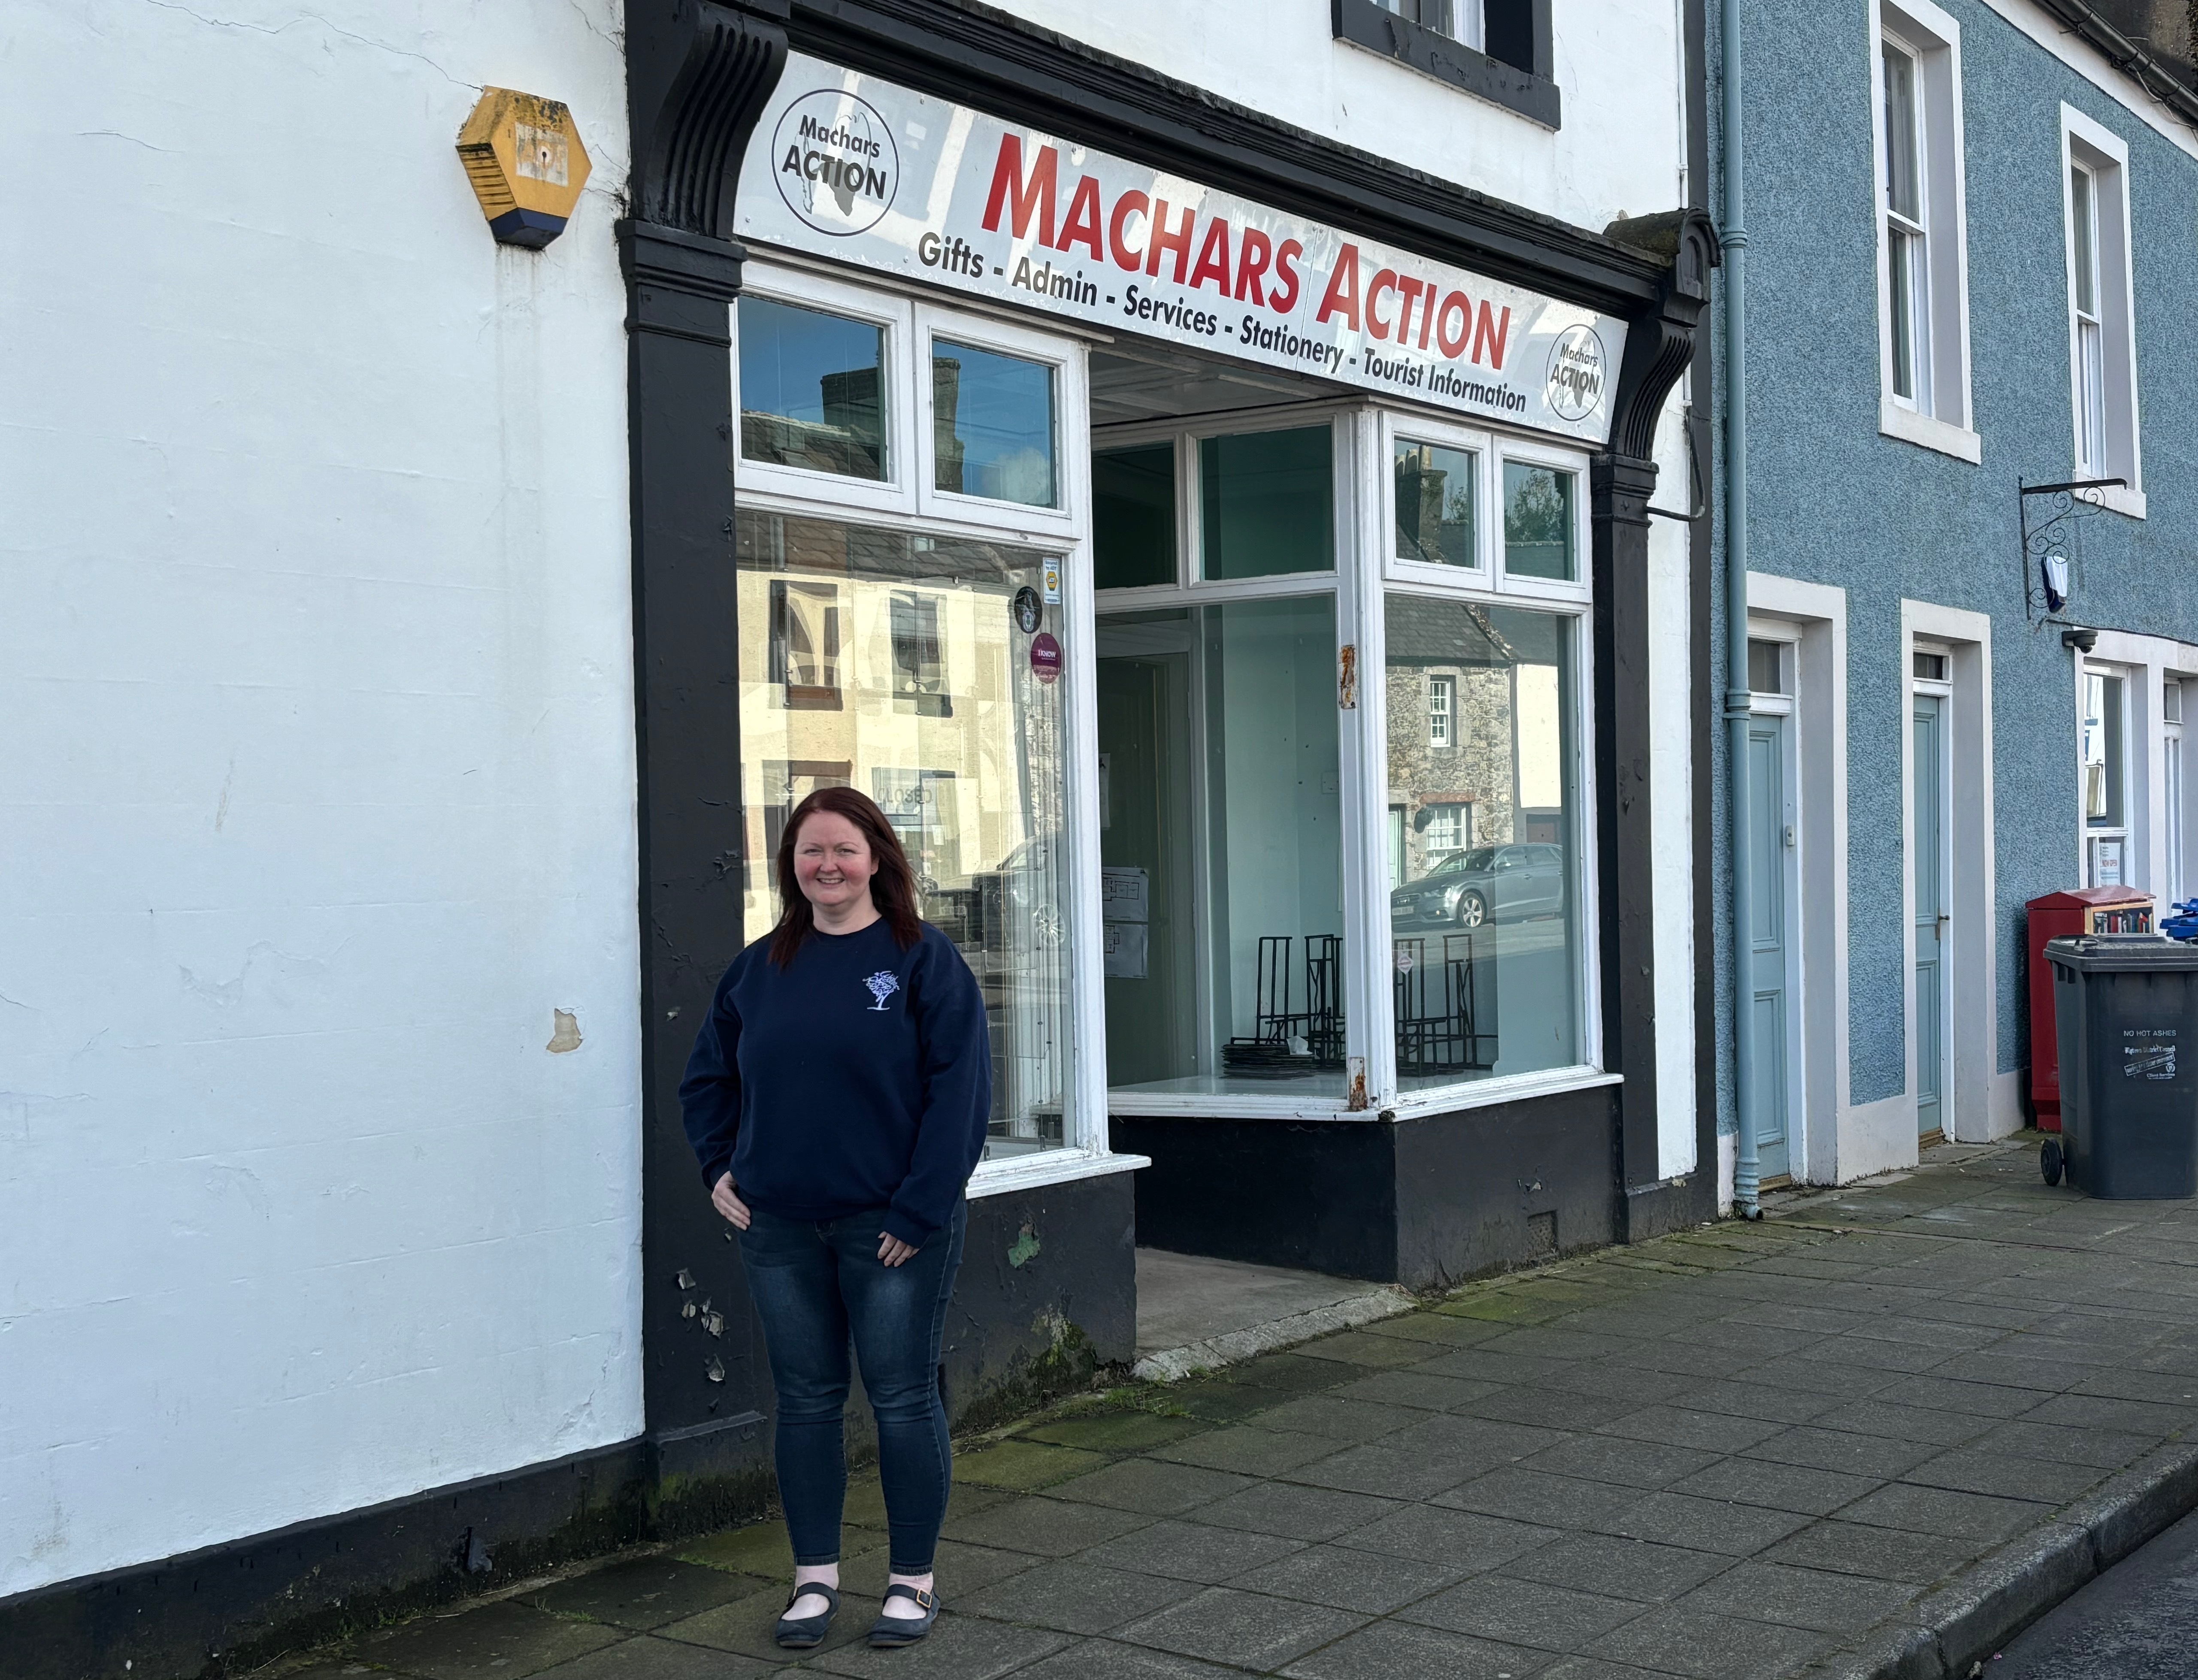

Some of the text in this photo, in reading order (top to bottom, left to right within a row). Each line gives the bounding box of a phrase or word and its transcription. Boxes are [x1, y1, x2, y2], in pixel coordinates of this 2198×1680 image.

[799, 114, 880, 158] Machars
[782, 145, 886, 199] ACTION
[981, 132, 1511, 370] MACHARS ACTION
[919, 232, 984, 278] Gifts
[1012, 257, 1097, 306] Admin
[1123, 284, 1217, 335] Services
[1240, 314, 1344, 373] Stationery
[1365, 347, 1423, 387] Tourist
[1428, 365, 1526, 412] Information
[1550, 363, 1600, 394] ACTION
[1560, 342, 1599, 367] Machars
